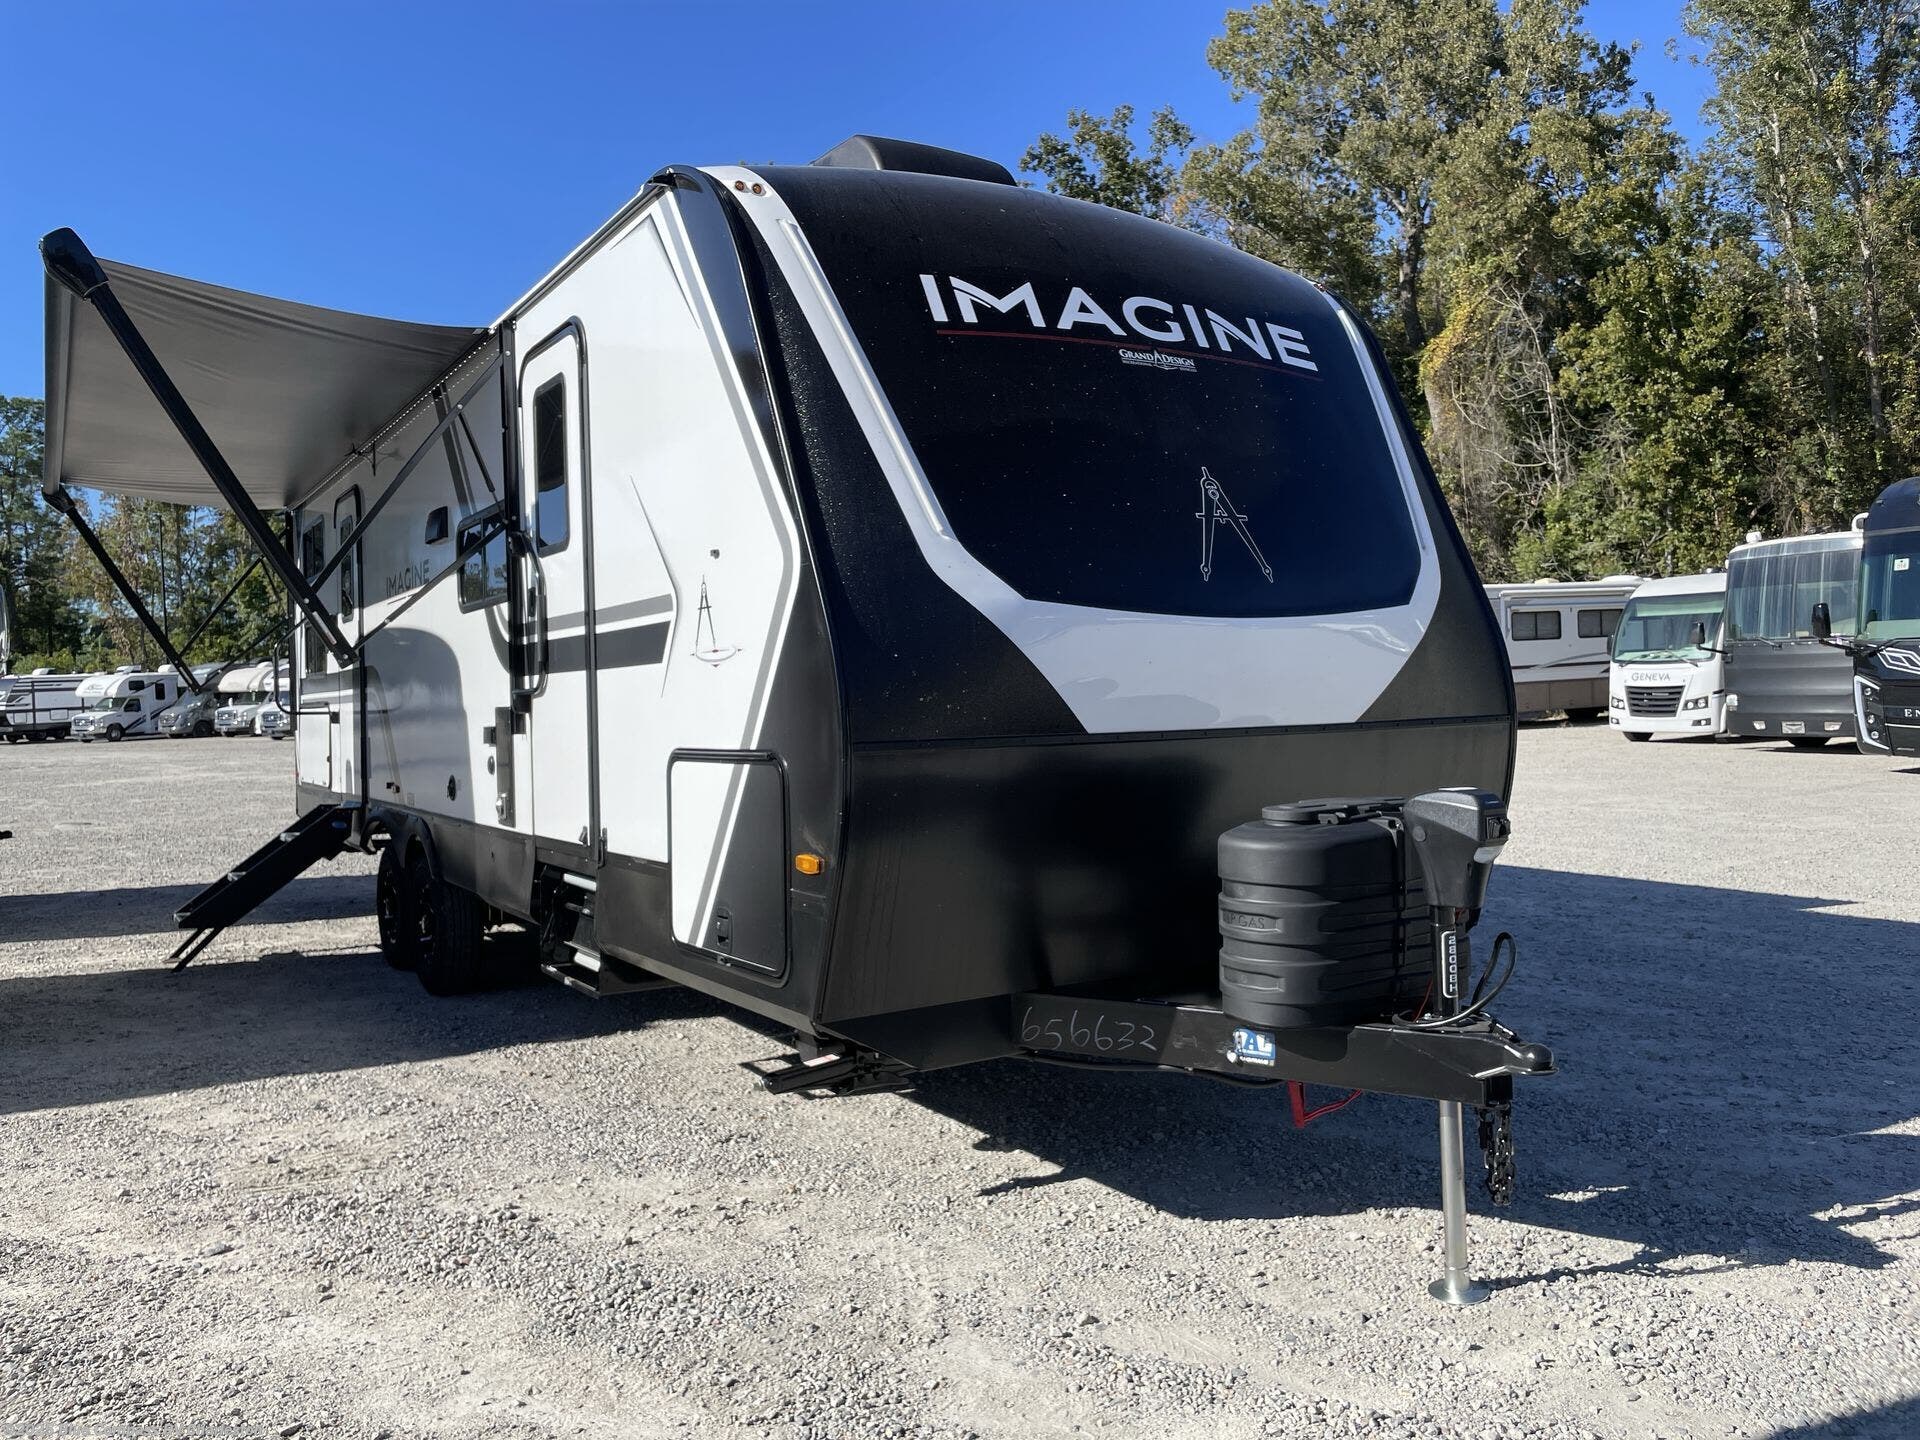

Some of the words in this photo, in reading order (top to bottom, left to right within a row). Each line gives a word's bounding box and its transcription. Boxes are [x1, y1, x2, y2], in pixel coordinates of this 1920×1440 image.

[919, 274, 1319, 372] IMAGINE
[1119, 348, 1154, 361] GRAND
[1161, 353, 1195, 367] DESIGN
[385, 558, 430, 600] IMAGINE
[1631, 672, 1671, 681] GENEVA
[1238, 914, 1265, 929] GAS
[1448, 935, 1458, 993] 2800BH
[1021, 1006, 1157, 1051] 656632
